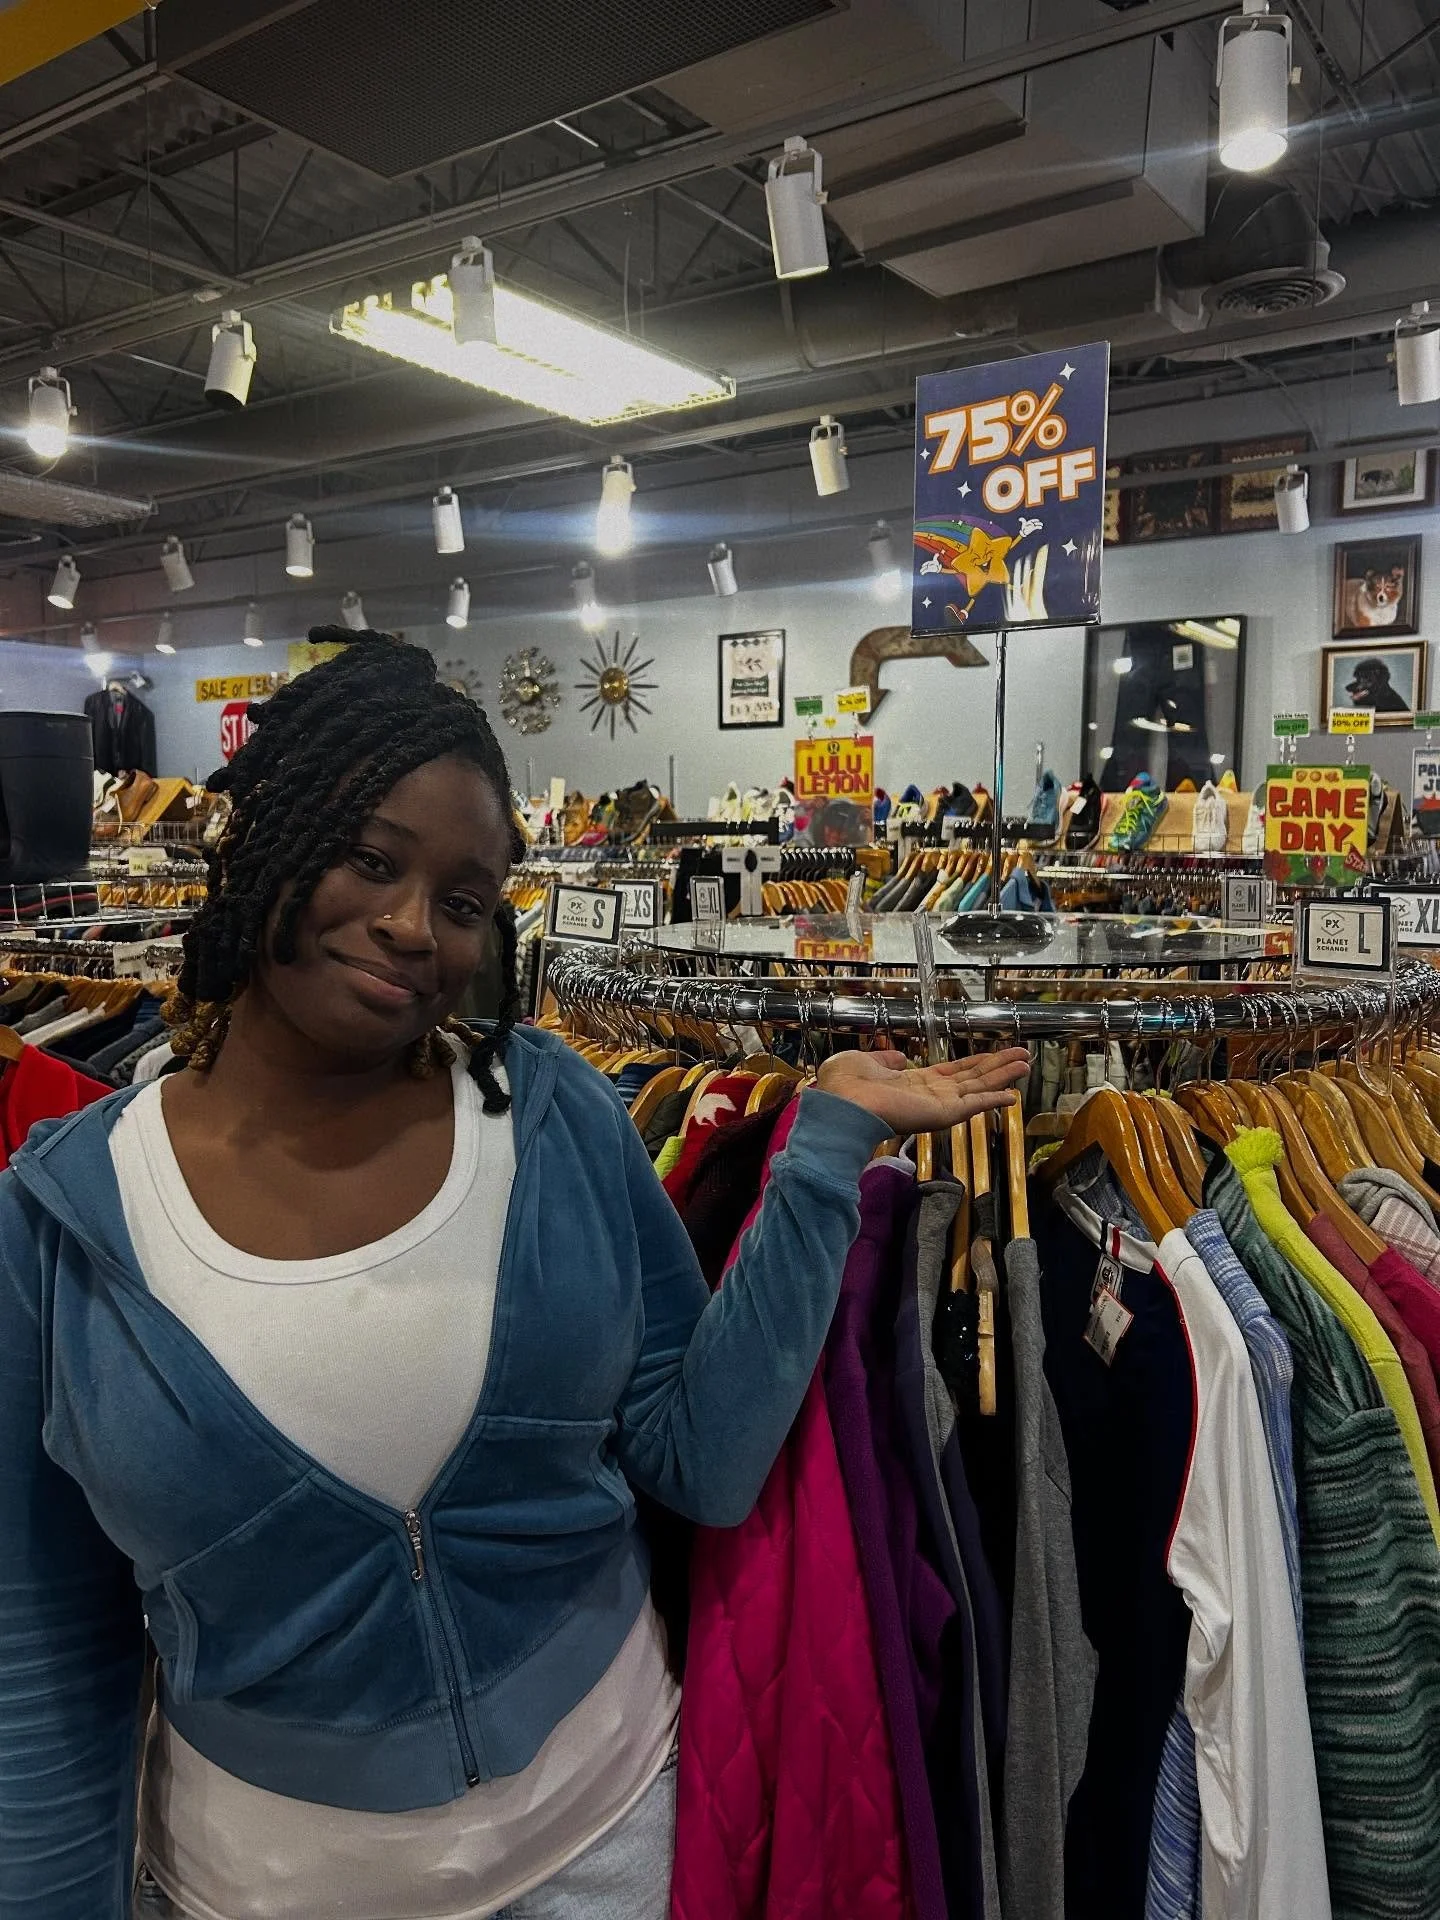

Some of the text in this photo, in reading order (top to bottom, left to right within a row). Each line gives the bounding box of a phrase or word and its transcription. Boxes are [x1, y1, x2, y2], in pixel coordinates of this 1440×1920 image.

[924, 382, 1067, 475] 75%
[982, 447, 1096, 514] OFF
[201, 680, 227, 701] SALE
[232, 683, 243, 697] or
[1353, 719, 1369, 727] OFF
[807, 755, 861, 775] LULU
[1418, 764, 1440, 776] PA
[800, 773, 869, 794] LEMON
[1269, 786, 1367, 819] GAME
[1280, 821, 1354, 852] DAY
[571, 901, 582, 910] PX
[633, 889, 651, 918] XS
[707, 887, 719, 914] XL
[1247, 885, 1257, 912] M
[592, 899, 606, 929] S
[1325, 919, 1340, 929] PX
[1414, 898, 1440, 934] XL
[1316, 937, 1349, 946] PLANET
[1358, 912, 1371, 954] L
